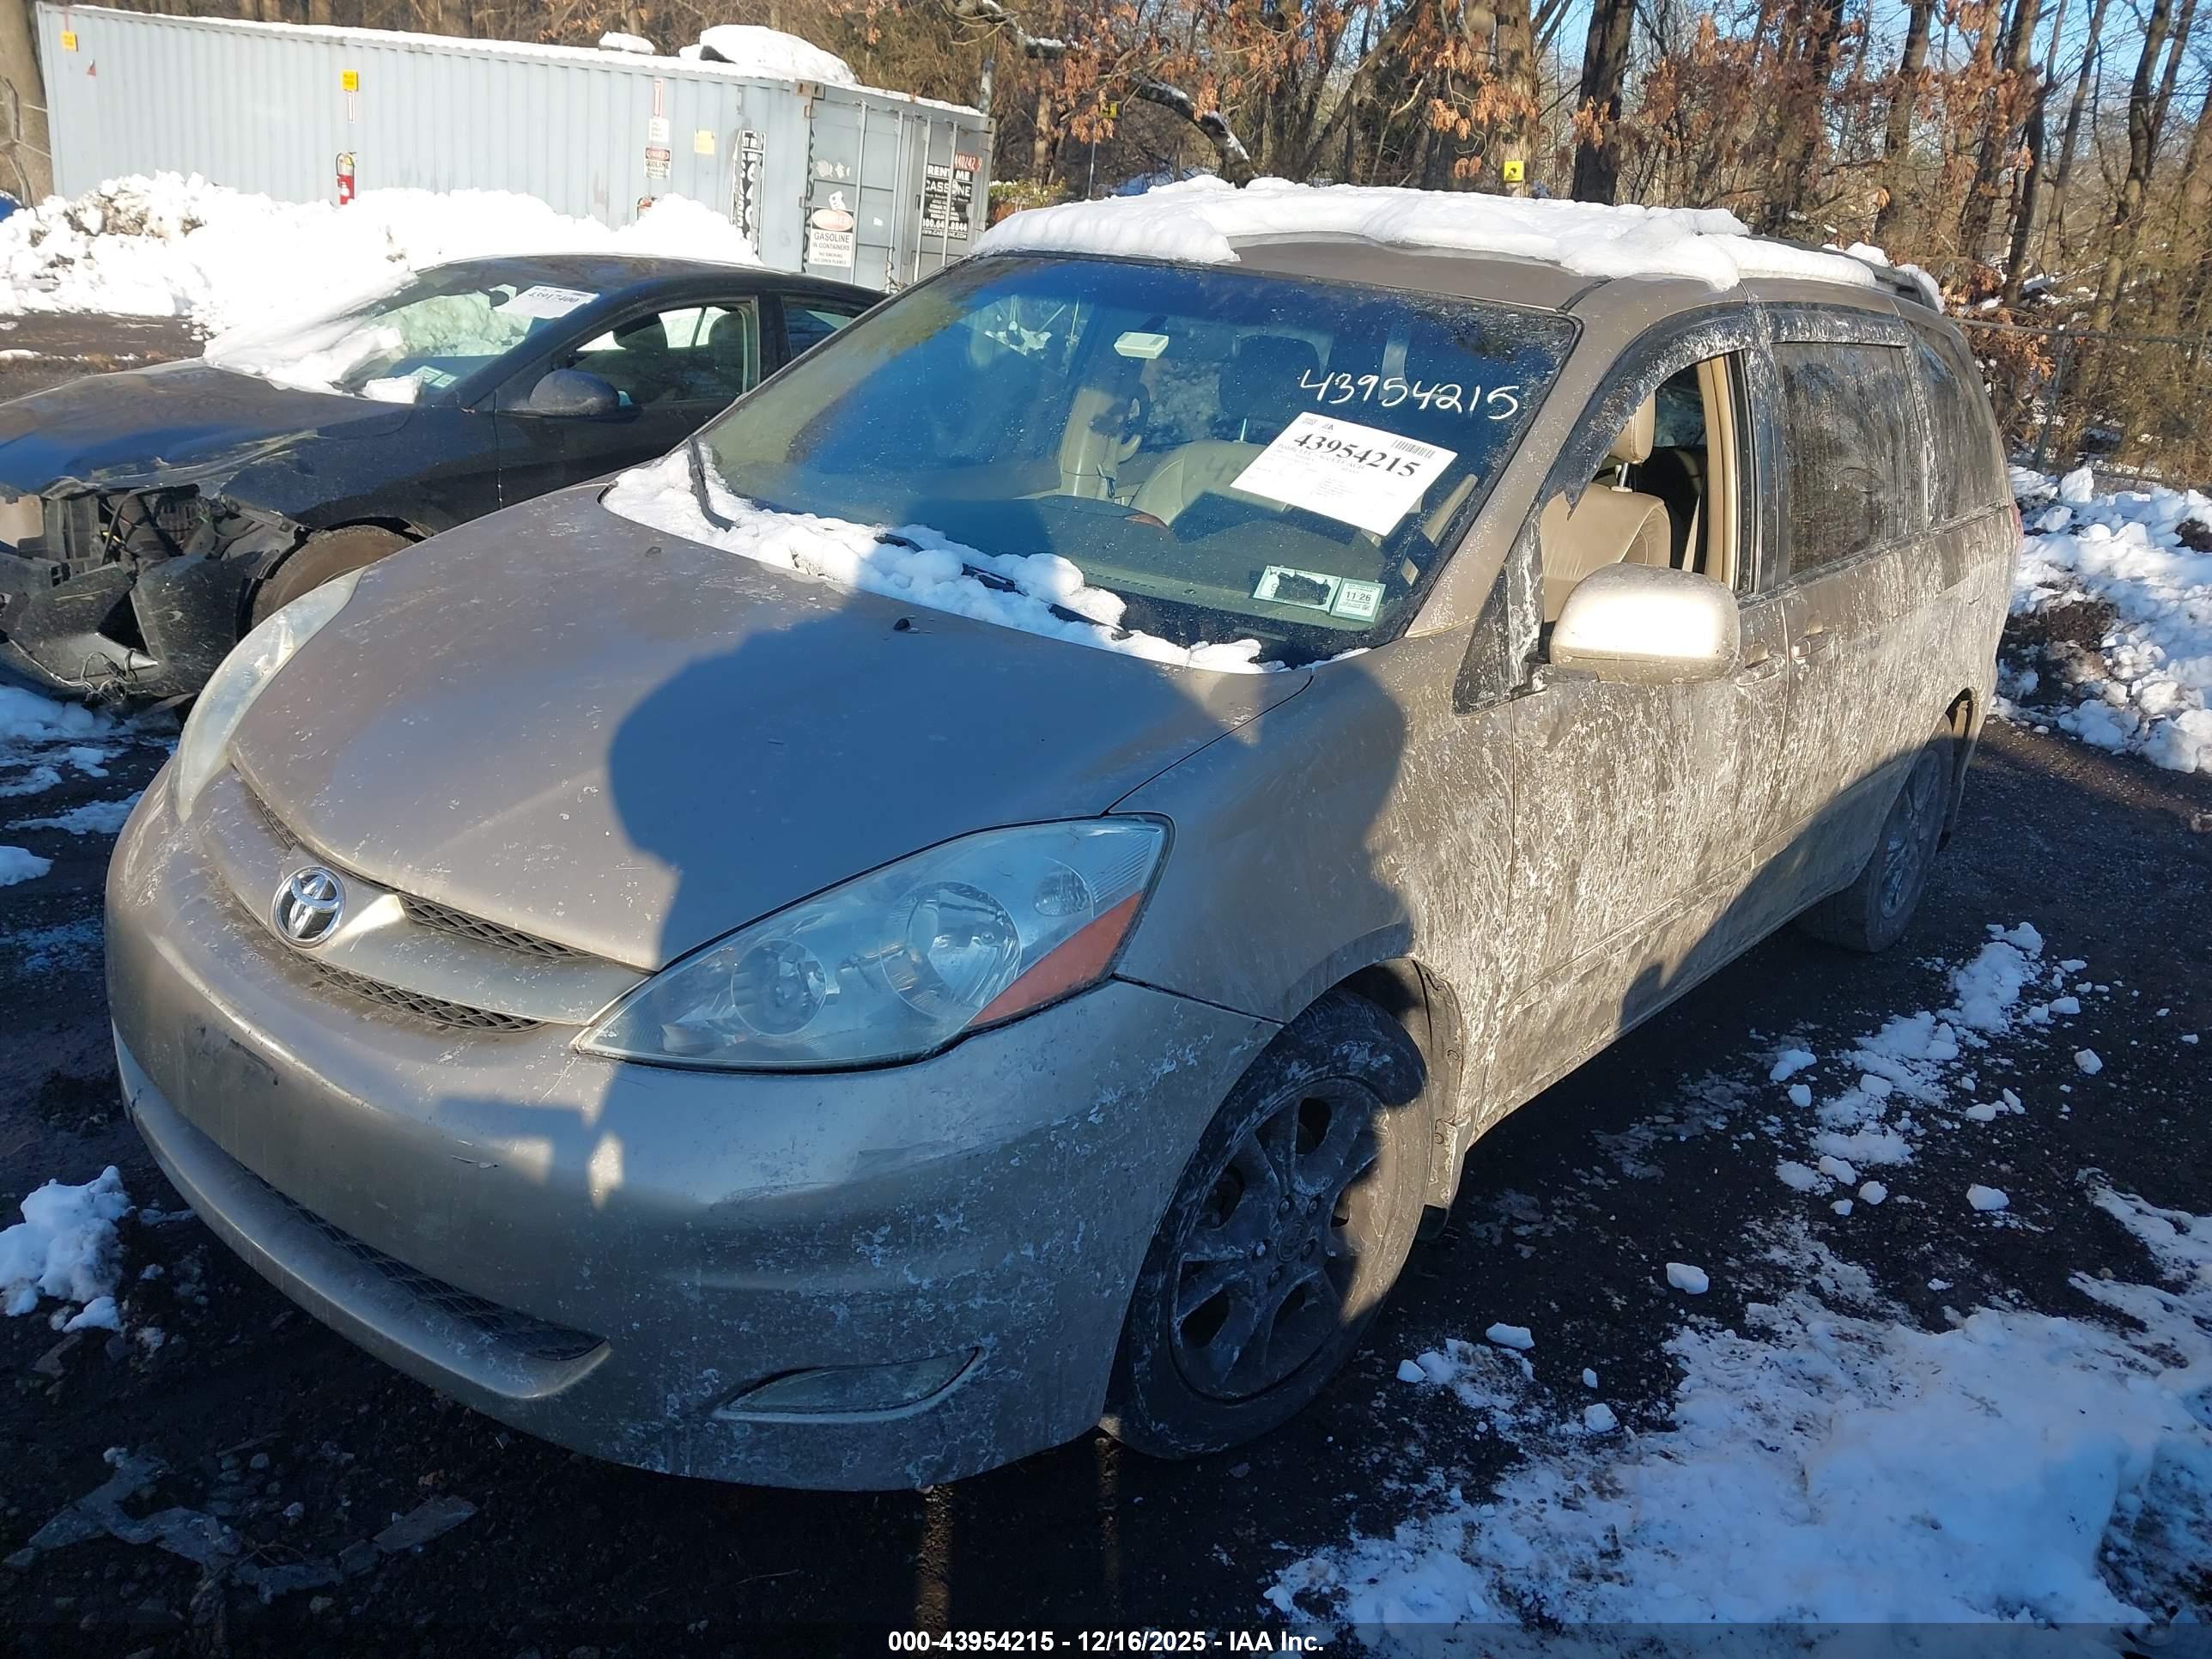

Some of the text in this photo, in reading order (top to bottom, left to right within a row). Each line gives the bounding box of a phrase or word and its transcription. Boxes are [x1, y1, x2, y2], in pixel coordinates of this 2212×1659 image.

[955, 170, 970, 181] ME
[813, 231, 850, 243] GASOLINE
[818, 242, 850, 252] CONTAINERS
[1299, 368, 1520, 420] 43954215
[1293, 432, 1422, 477] 43954215
